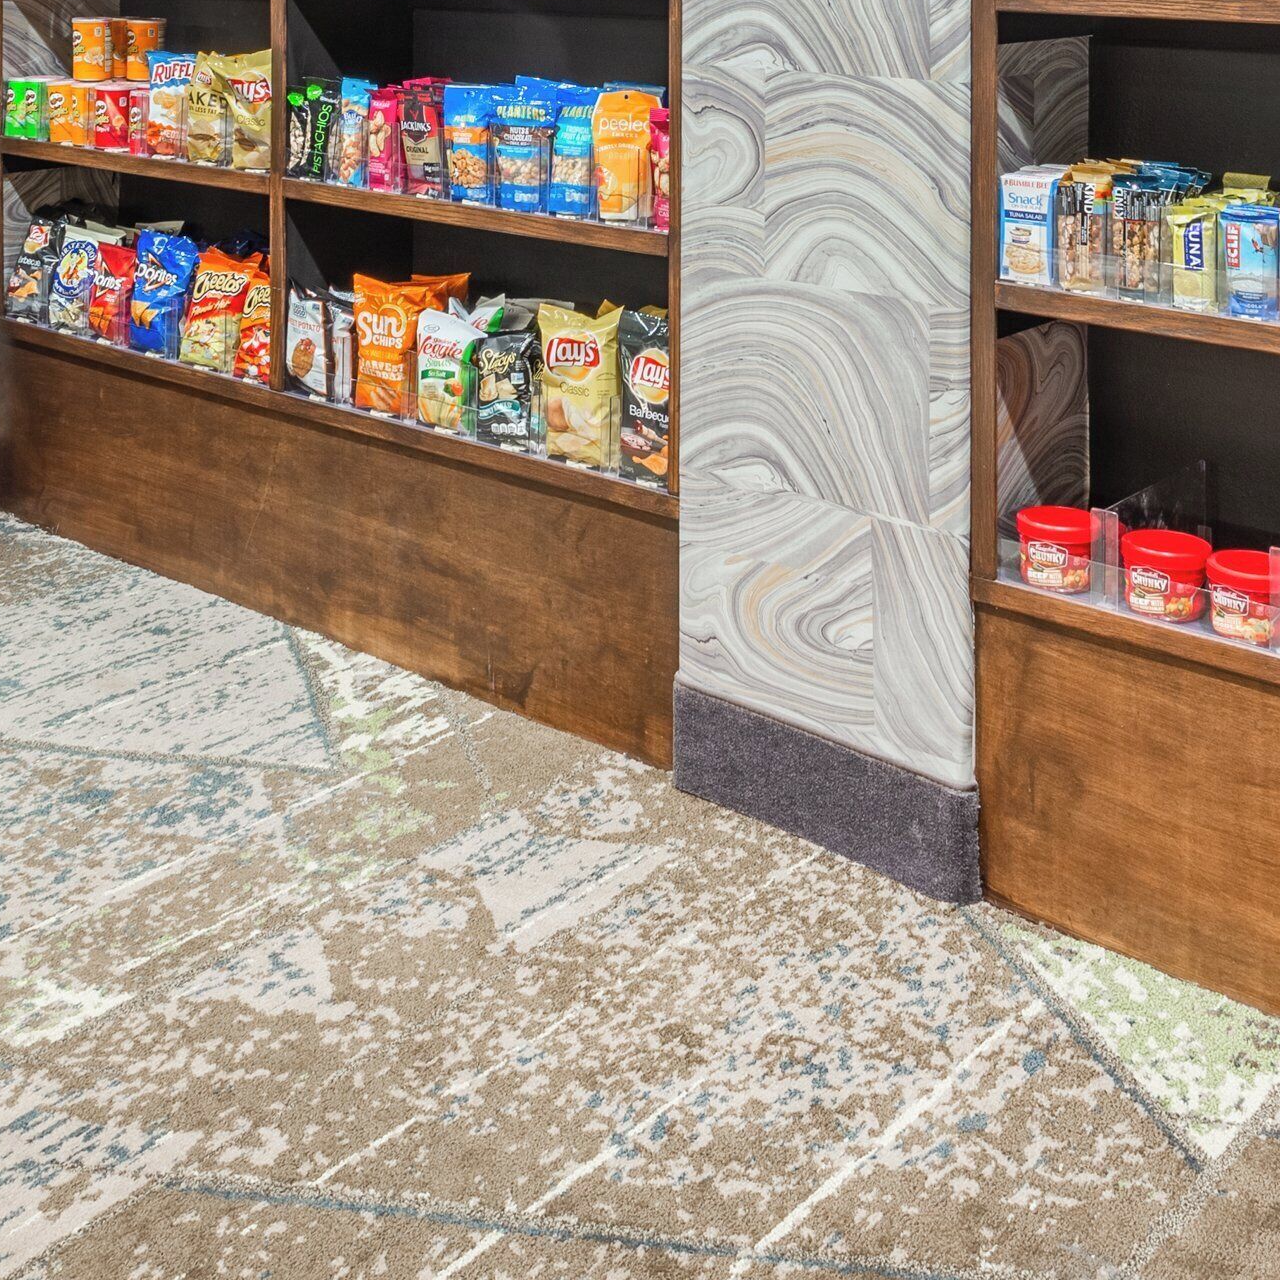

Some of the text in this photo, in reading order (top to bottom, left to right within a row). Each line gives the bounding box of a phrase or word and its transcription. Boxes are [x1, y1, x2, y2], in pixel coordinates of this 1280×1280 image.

[497, 105, 546, 122] PLANTERS
[313, 104, 332, 173] PISTACHIOS
[504, 133, 532, 142] CHOCOLATE
[1008, 192, 1042, 206] Snack
[1084, 182, 1096, 218] KIND
[1025, 212, 1043, 220] SALAD
[1187, 220, 1206, 270] LUNA
[1226, 224, 1240, 258] CLIF
[136, 264, 177, 286] Doritos
[193, 271, 248, 302] Cheetos
[358, 304, 407, 346] Sun
[373, 335, 403, 349] CHIPS
[418, 341, 463, 359] Veggie
[548, 338, 599, 368] Lay's
[479, 347, 517, 374] Stacy's
[559, 381, 590, 397] Classic
[1029, 548, 1066, 564] CHUNKY
[1132, 573, 1168, 591] CHUNKY
[1212, 590, 1248, 612] CHUNKY
